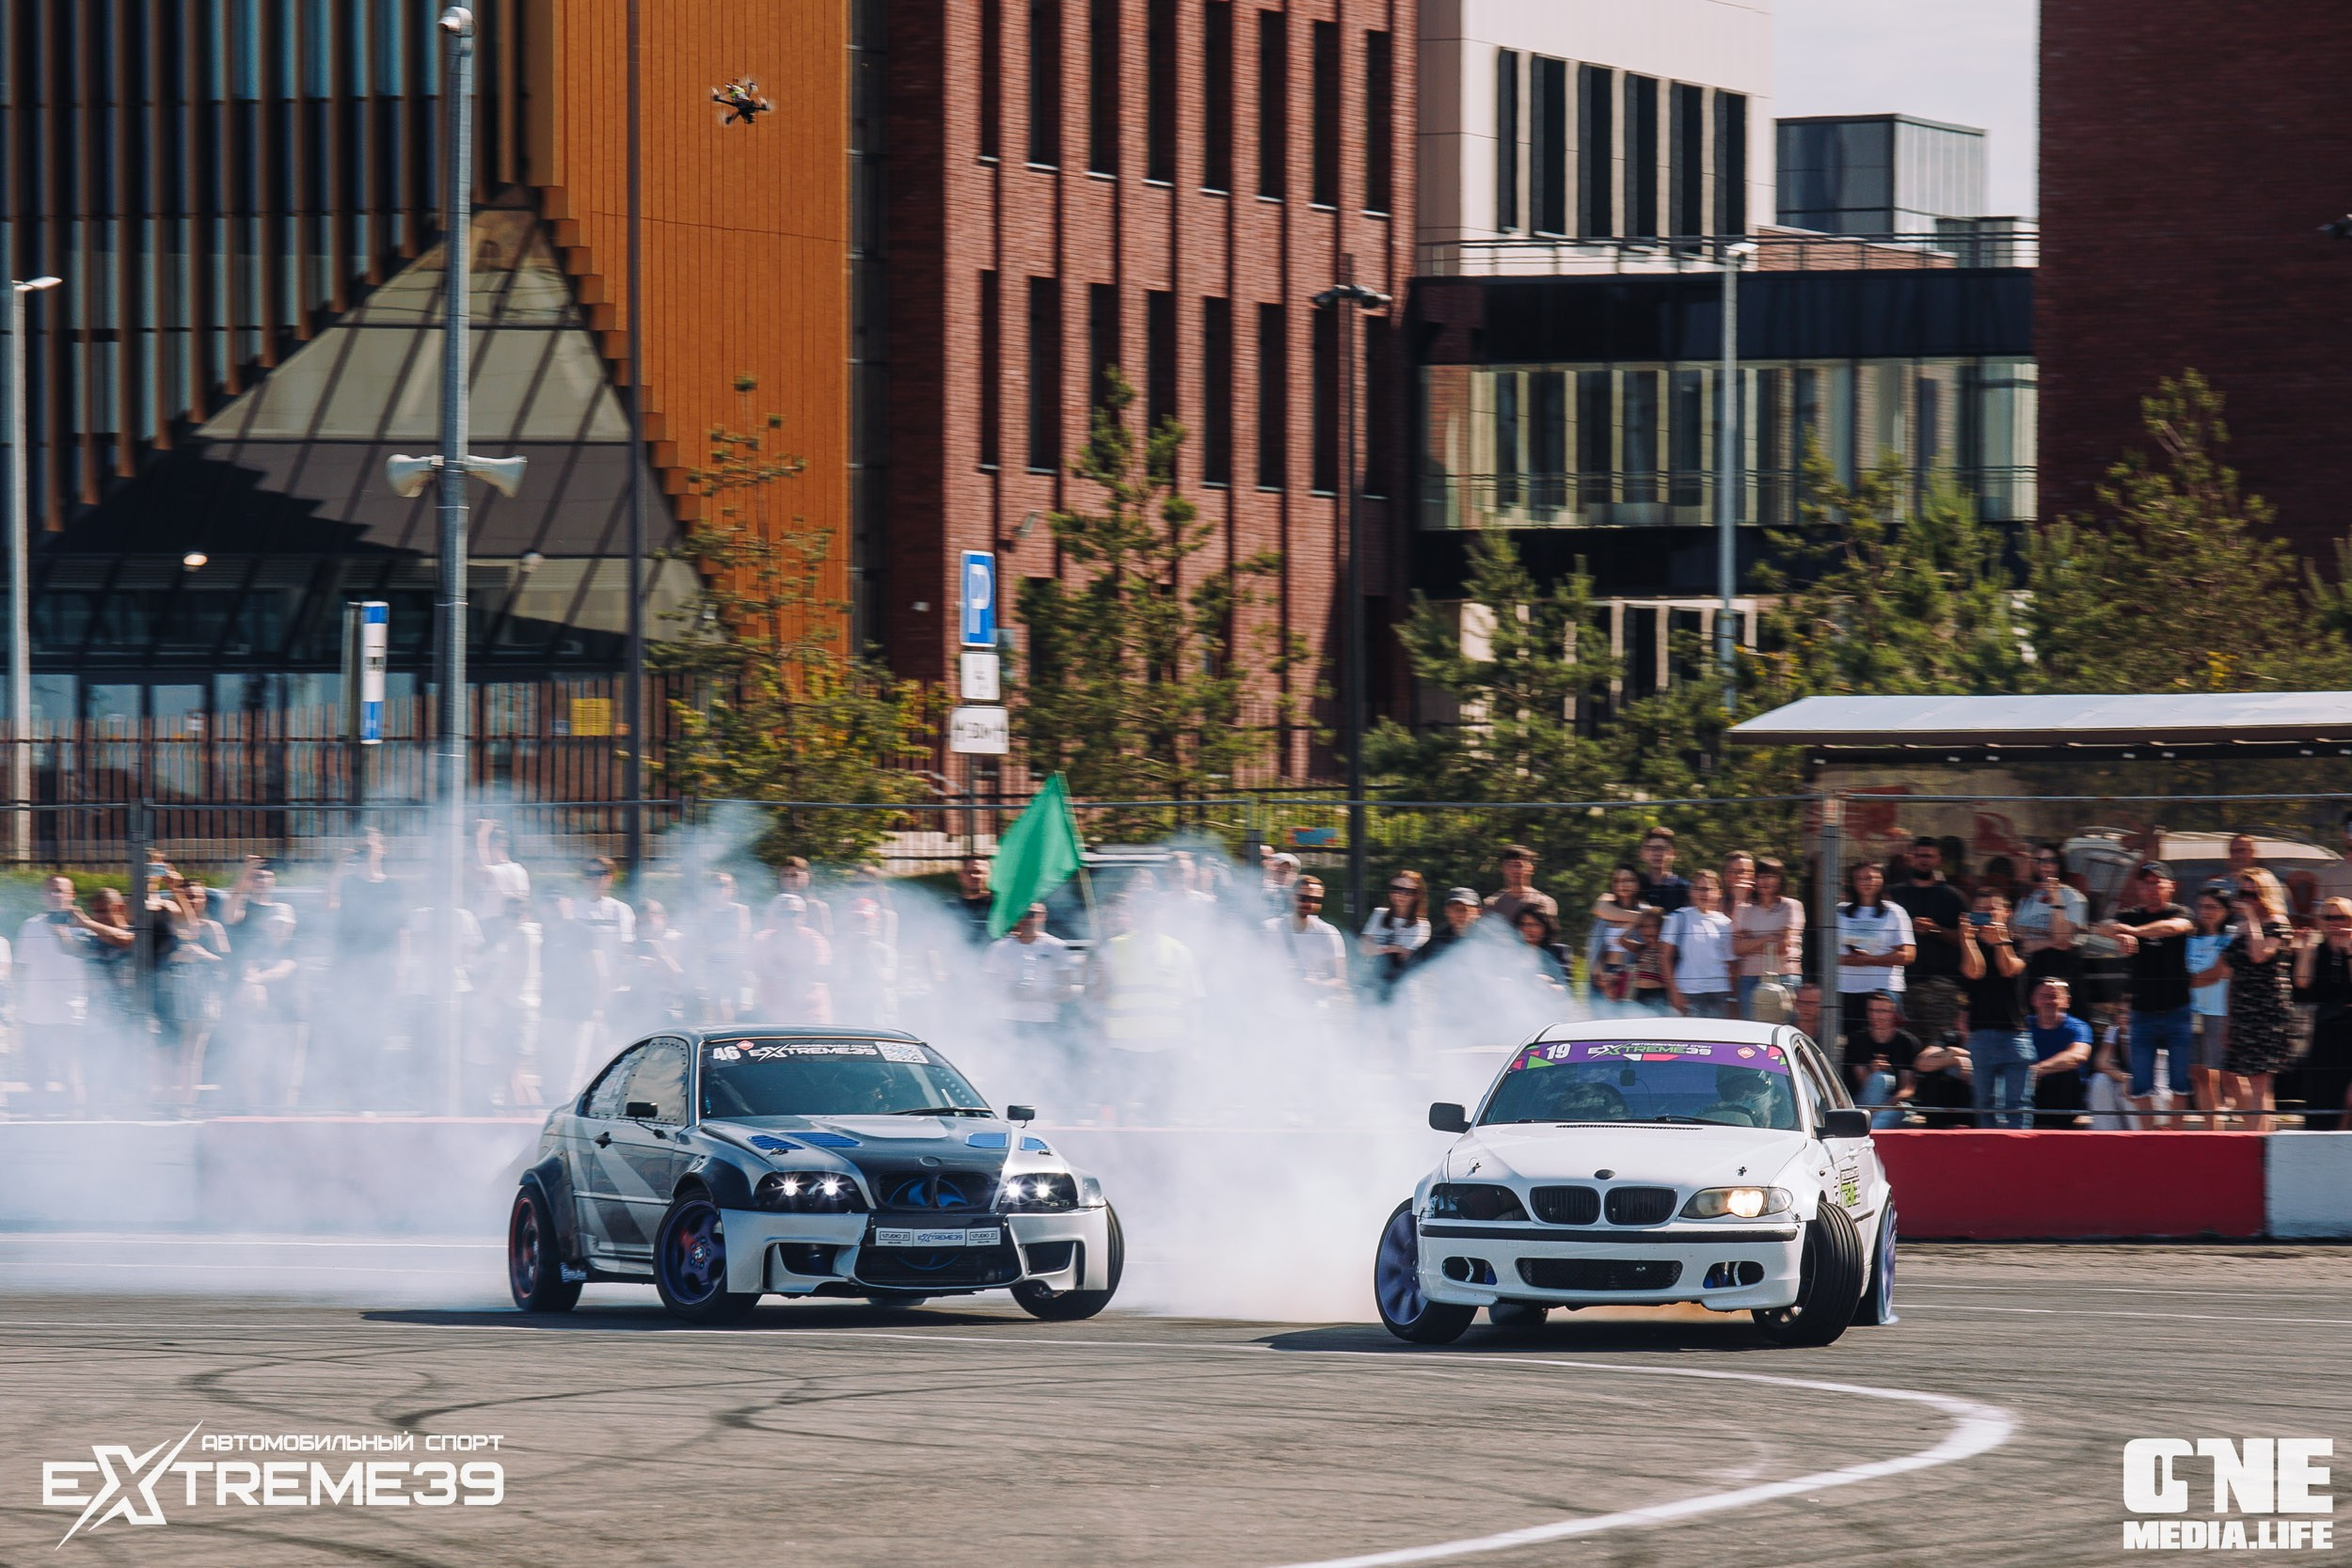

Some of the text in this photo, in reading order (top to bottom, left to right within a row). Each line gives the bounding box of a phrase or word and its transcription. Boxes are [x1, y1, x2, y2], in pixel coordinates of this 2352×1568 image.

[968, 563, 992, 635] P
[712, 1045, 742, 1061] 46
[748, 1043, 878, 1062] EXTREME39
[1546, 1043, 1571, 1060] 19
[1587, 1041, 1712, 1060] EXTREME39
[917, 1231, 963, 1243] EXTREME39
